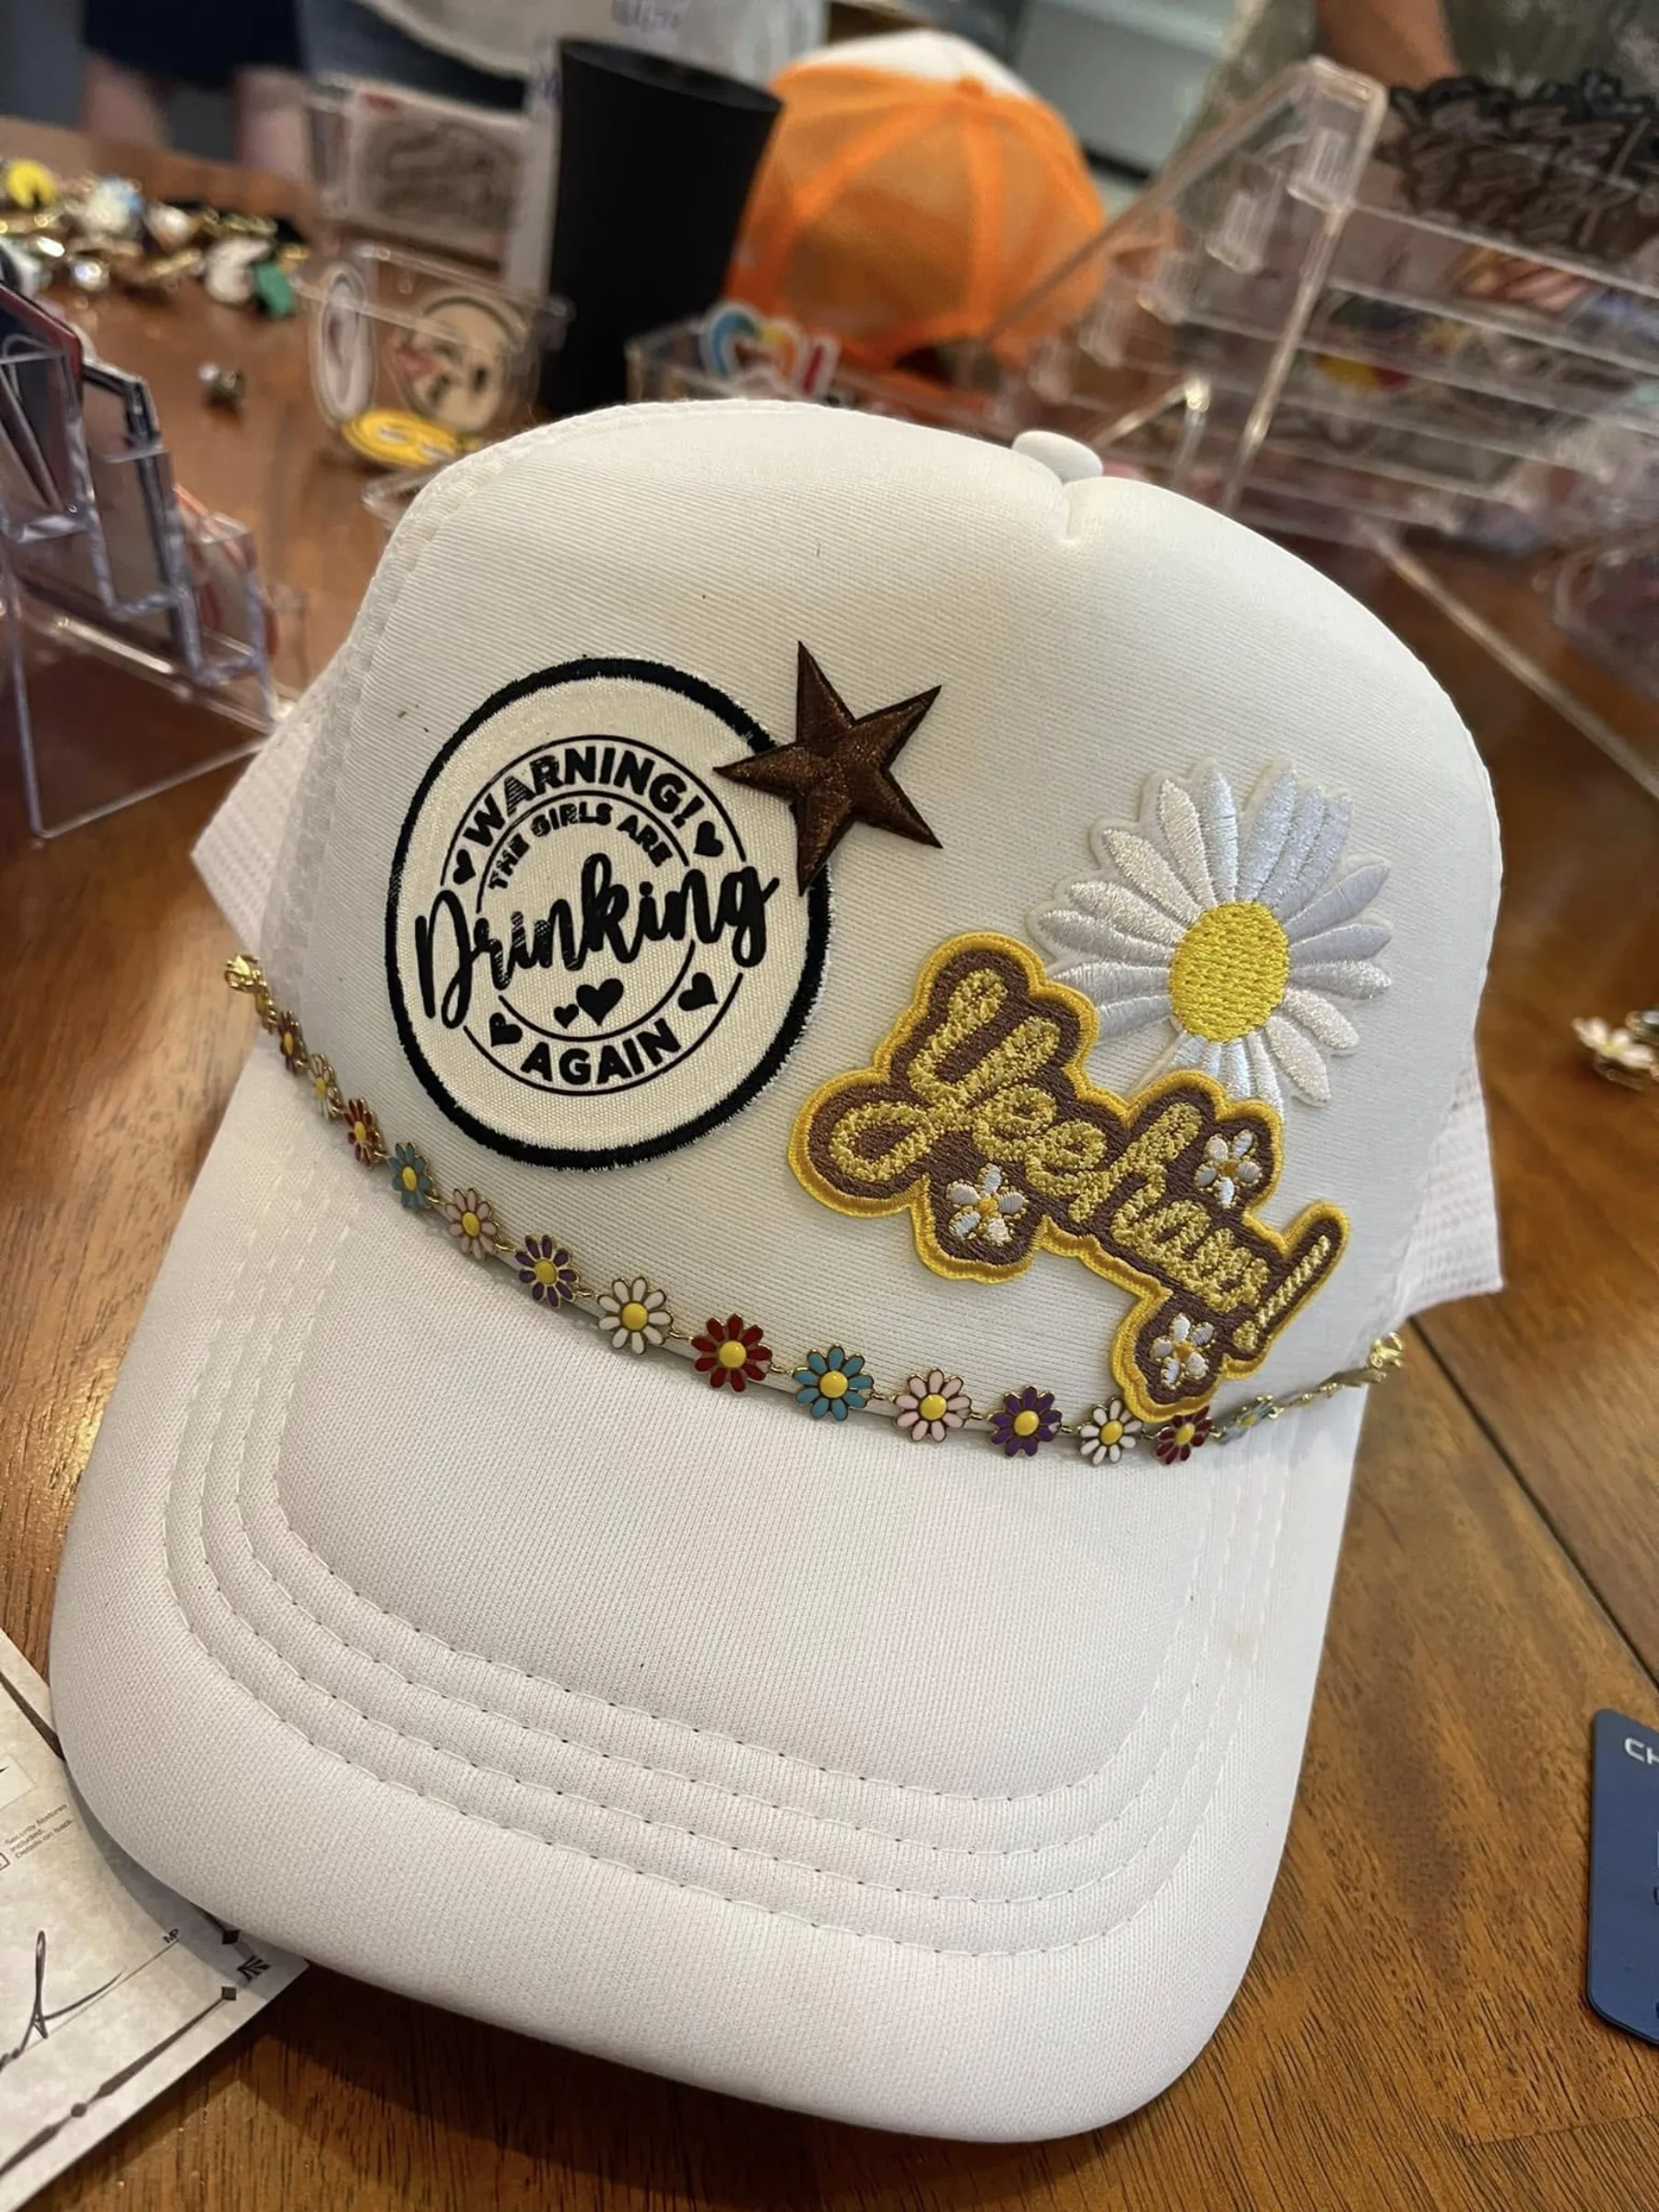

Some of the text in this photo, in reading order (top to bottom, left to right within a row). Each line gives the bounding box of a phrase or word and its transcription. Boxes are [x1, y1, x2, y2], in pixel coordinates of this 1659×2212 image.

[463, 746, 705, 846] WARNING!
[488, 801, 674, 889] THE GIRLS ARE
[414, 853, 780, 1030] Drinking
[520, 1018, 682, 1086] AGAIN
